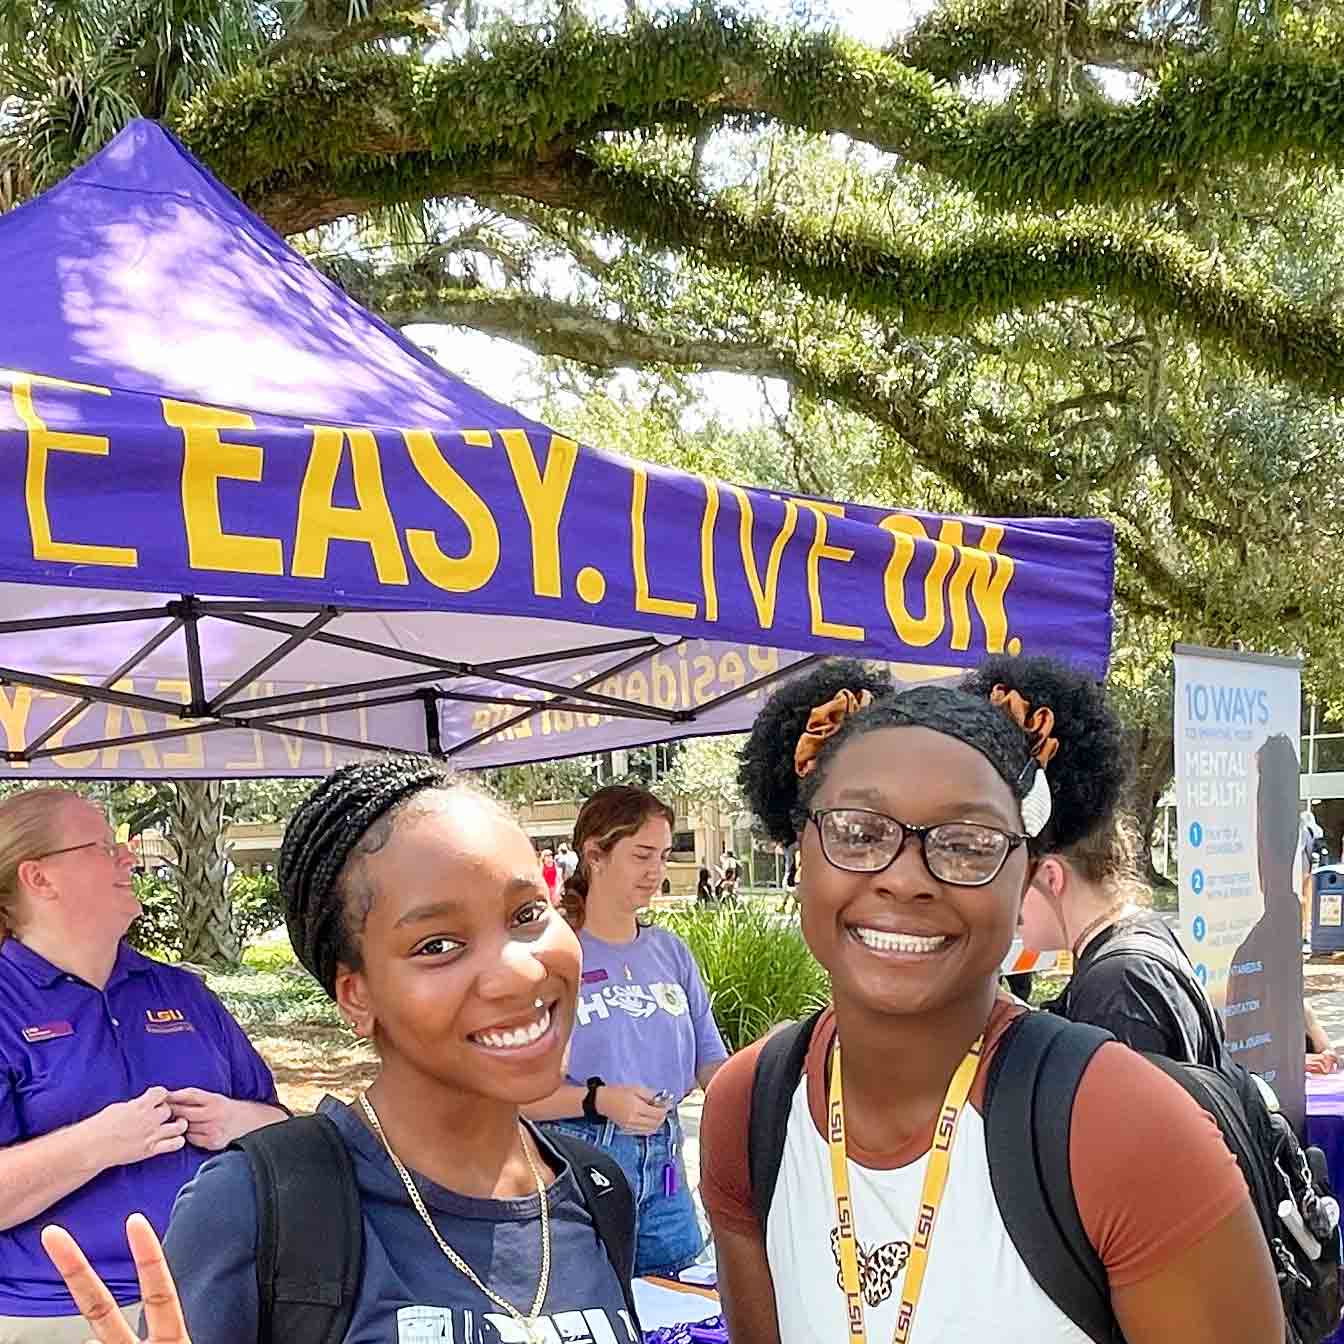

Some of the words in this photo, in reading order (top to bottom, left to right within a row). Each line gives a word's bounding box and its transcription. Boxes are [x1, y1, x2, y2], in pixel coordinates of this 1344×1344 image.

[160, 400, 605, 604] EASY.
[631, 464, 865, 641] LIVE
[878, 514, 1022, 656] ON.
[1184, 683, 1208, 721] 10
[1210, 687, 1269, 726] WAYS
[1184, 751, 1248, 777] MENTAL
[1184, 781, 1248, 808] HEALTH
[146, 1008, 184, 1022] LSU
[830, 1101, 844, 1143] LSU
[934, 1106, 958, 1152] LSU
[837, 1195, 852, 1239] LSU
[914, 1204, 935, 1250] LSU
[847, 1292, 863, 1335] LSU
